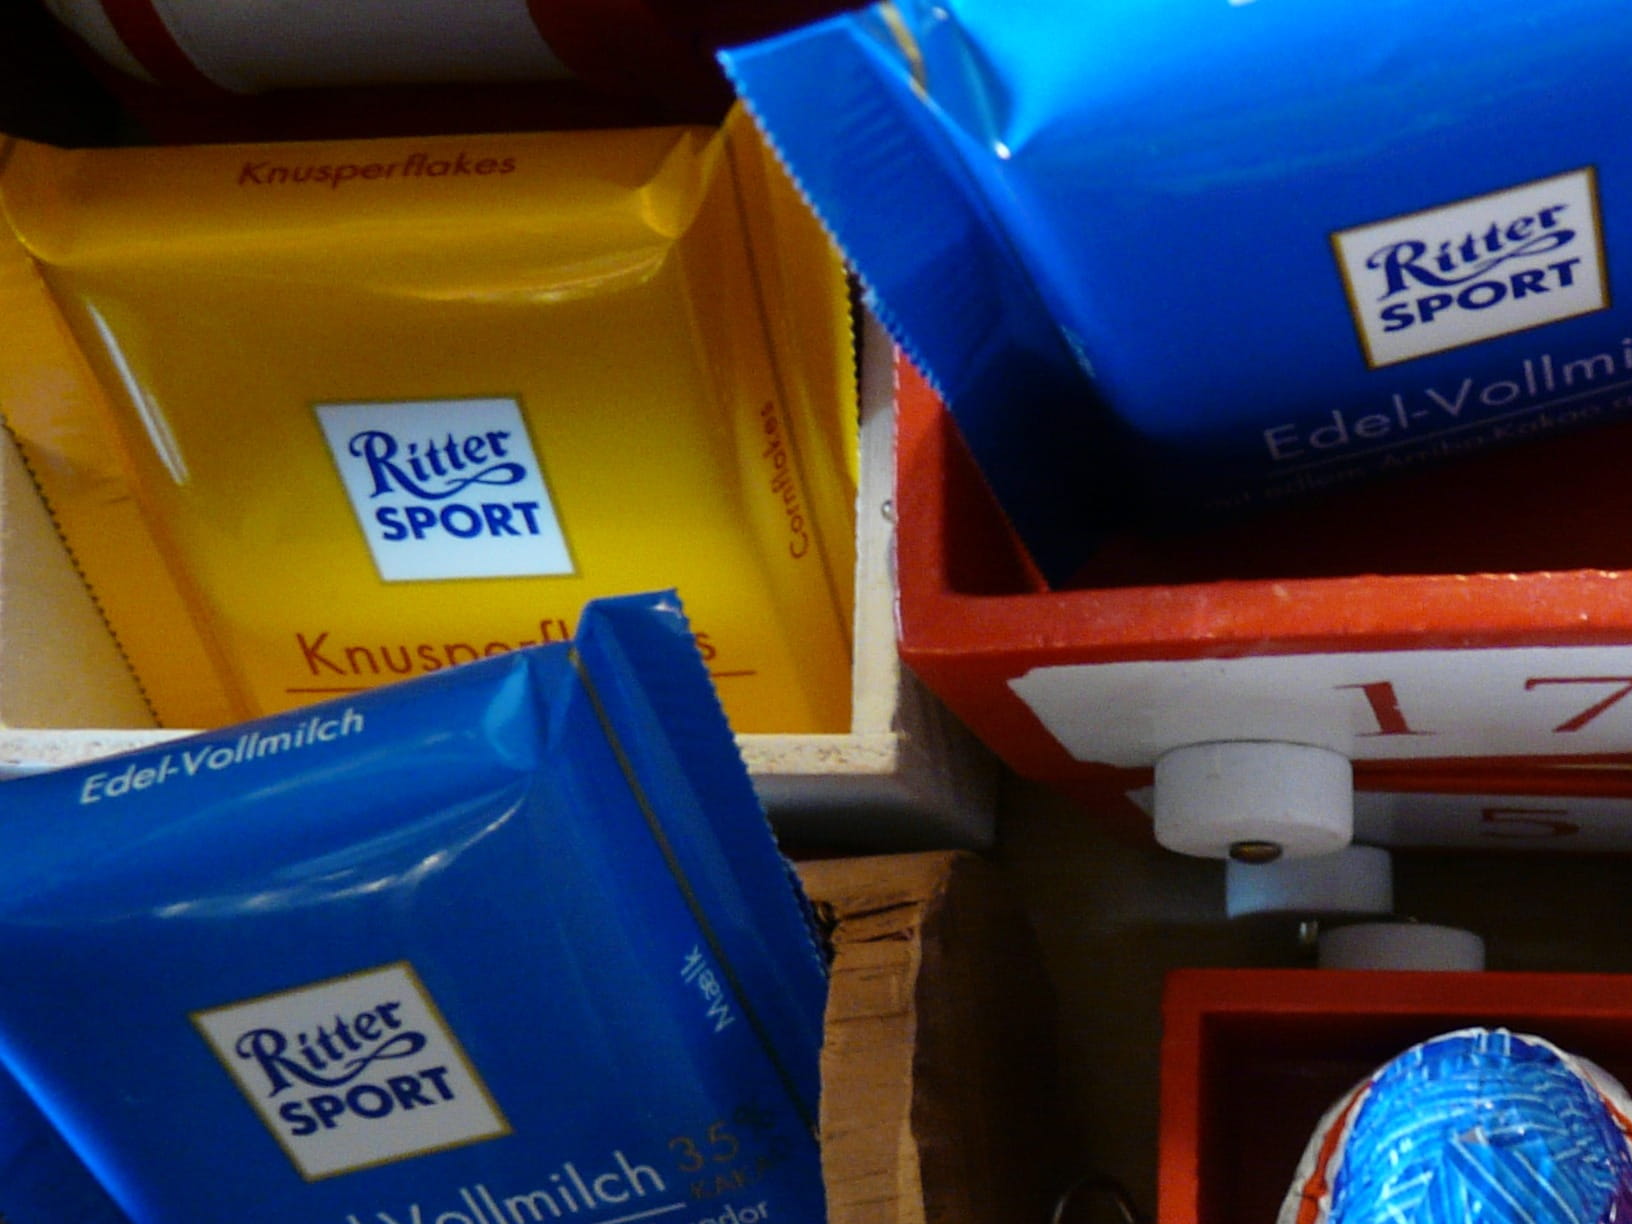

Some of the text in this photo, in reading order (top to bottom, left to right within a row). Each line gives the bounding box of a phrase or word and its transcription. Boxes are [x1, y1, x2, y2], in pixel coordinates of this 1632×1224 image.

[238, 150, 516, 190] Knusperflakes
[1366, 204, 1576, 302] Ritter
[1379, 258, 1581, 332] SPORT
[348, 430, 527, 500] Ritter
[760, 402, 808, 558] Cornflakes
[375, 502, 541, 541] SPORT
[80, 707, 364, 804] Edel-Vollmilch
[1482, 807, 1580, 838] 5
[235, 1001, 427, 1097] Ritter
[279, 1066, 455, 1136] SPORT
